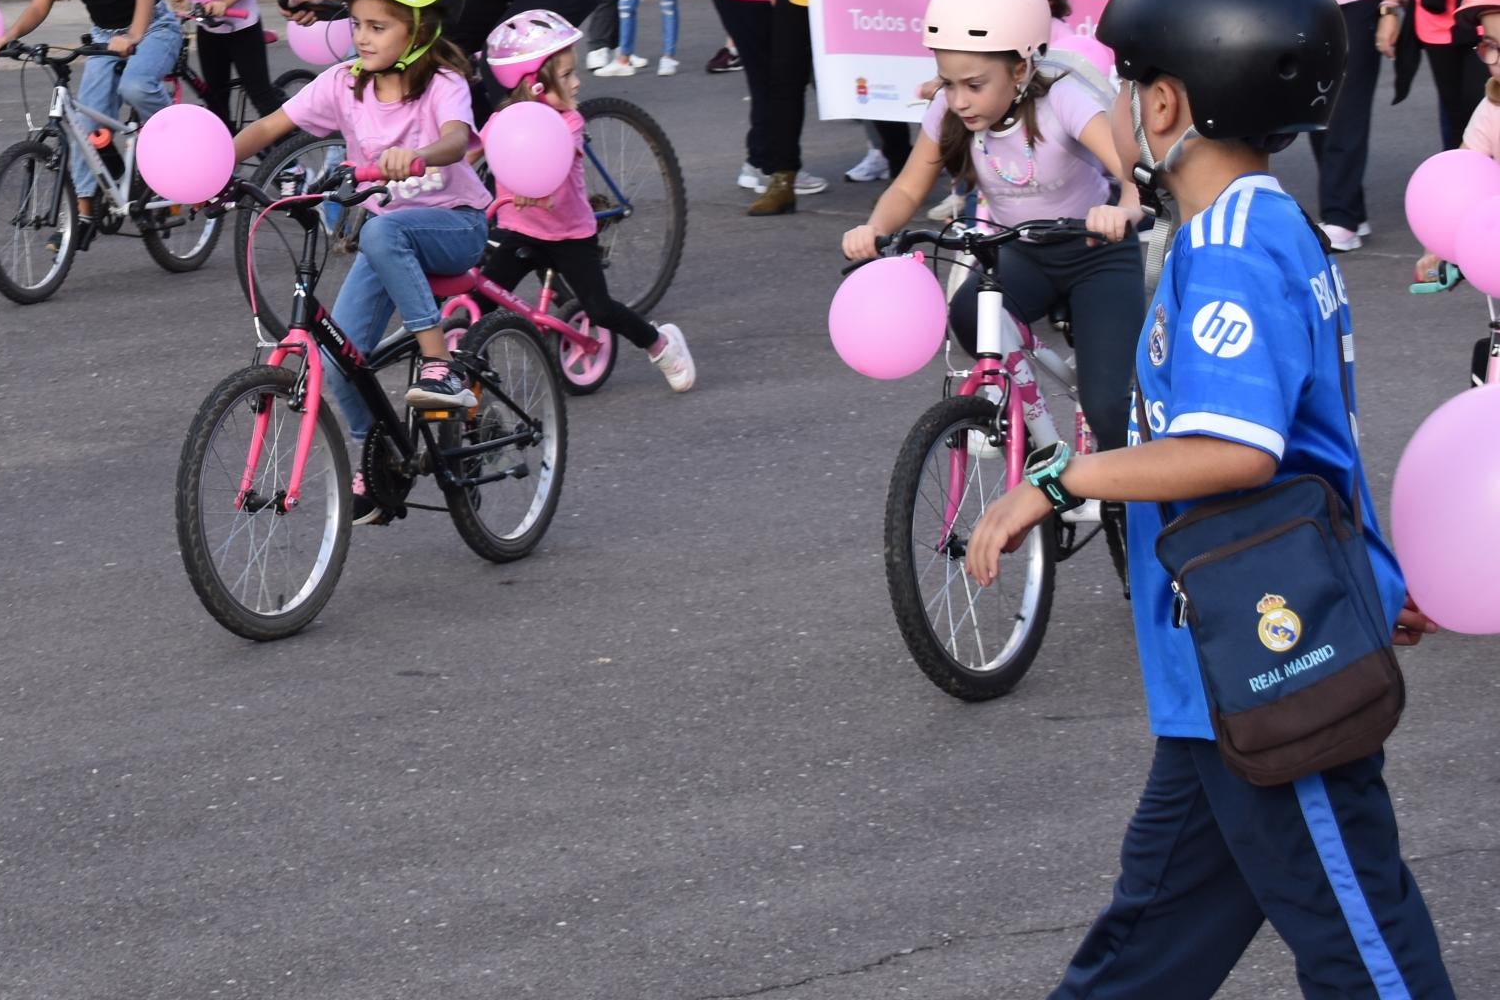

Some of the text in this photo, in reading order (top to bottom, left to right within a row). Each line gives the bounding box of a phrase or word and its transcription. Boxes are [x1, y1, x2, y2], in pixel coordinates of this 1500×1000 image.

[846, 8, 906, 32] Todos
[1199, 301, 1247, 357] hp
[1248, 644, 1335, 693] REAL MADRID
